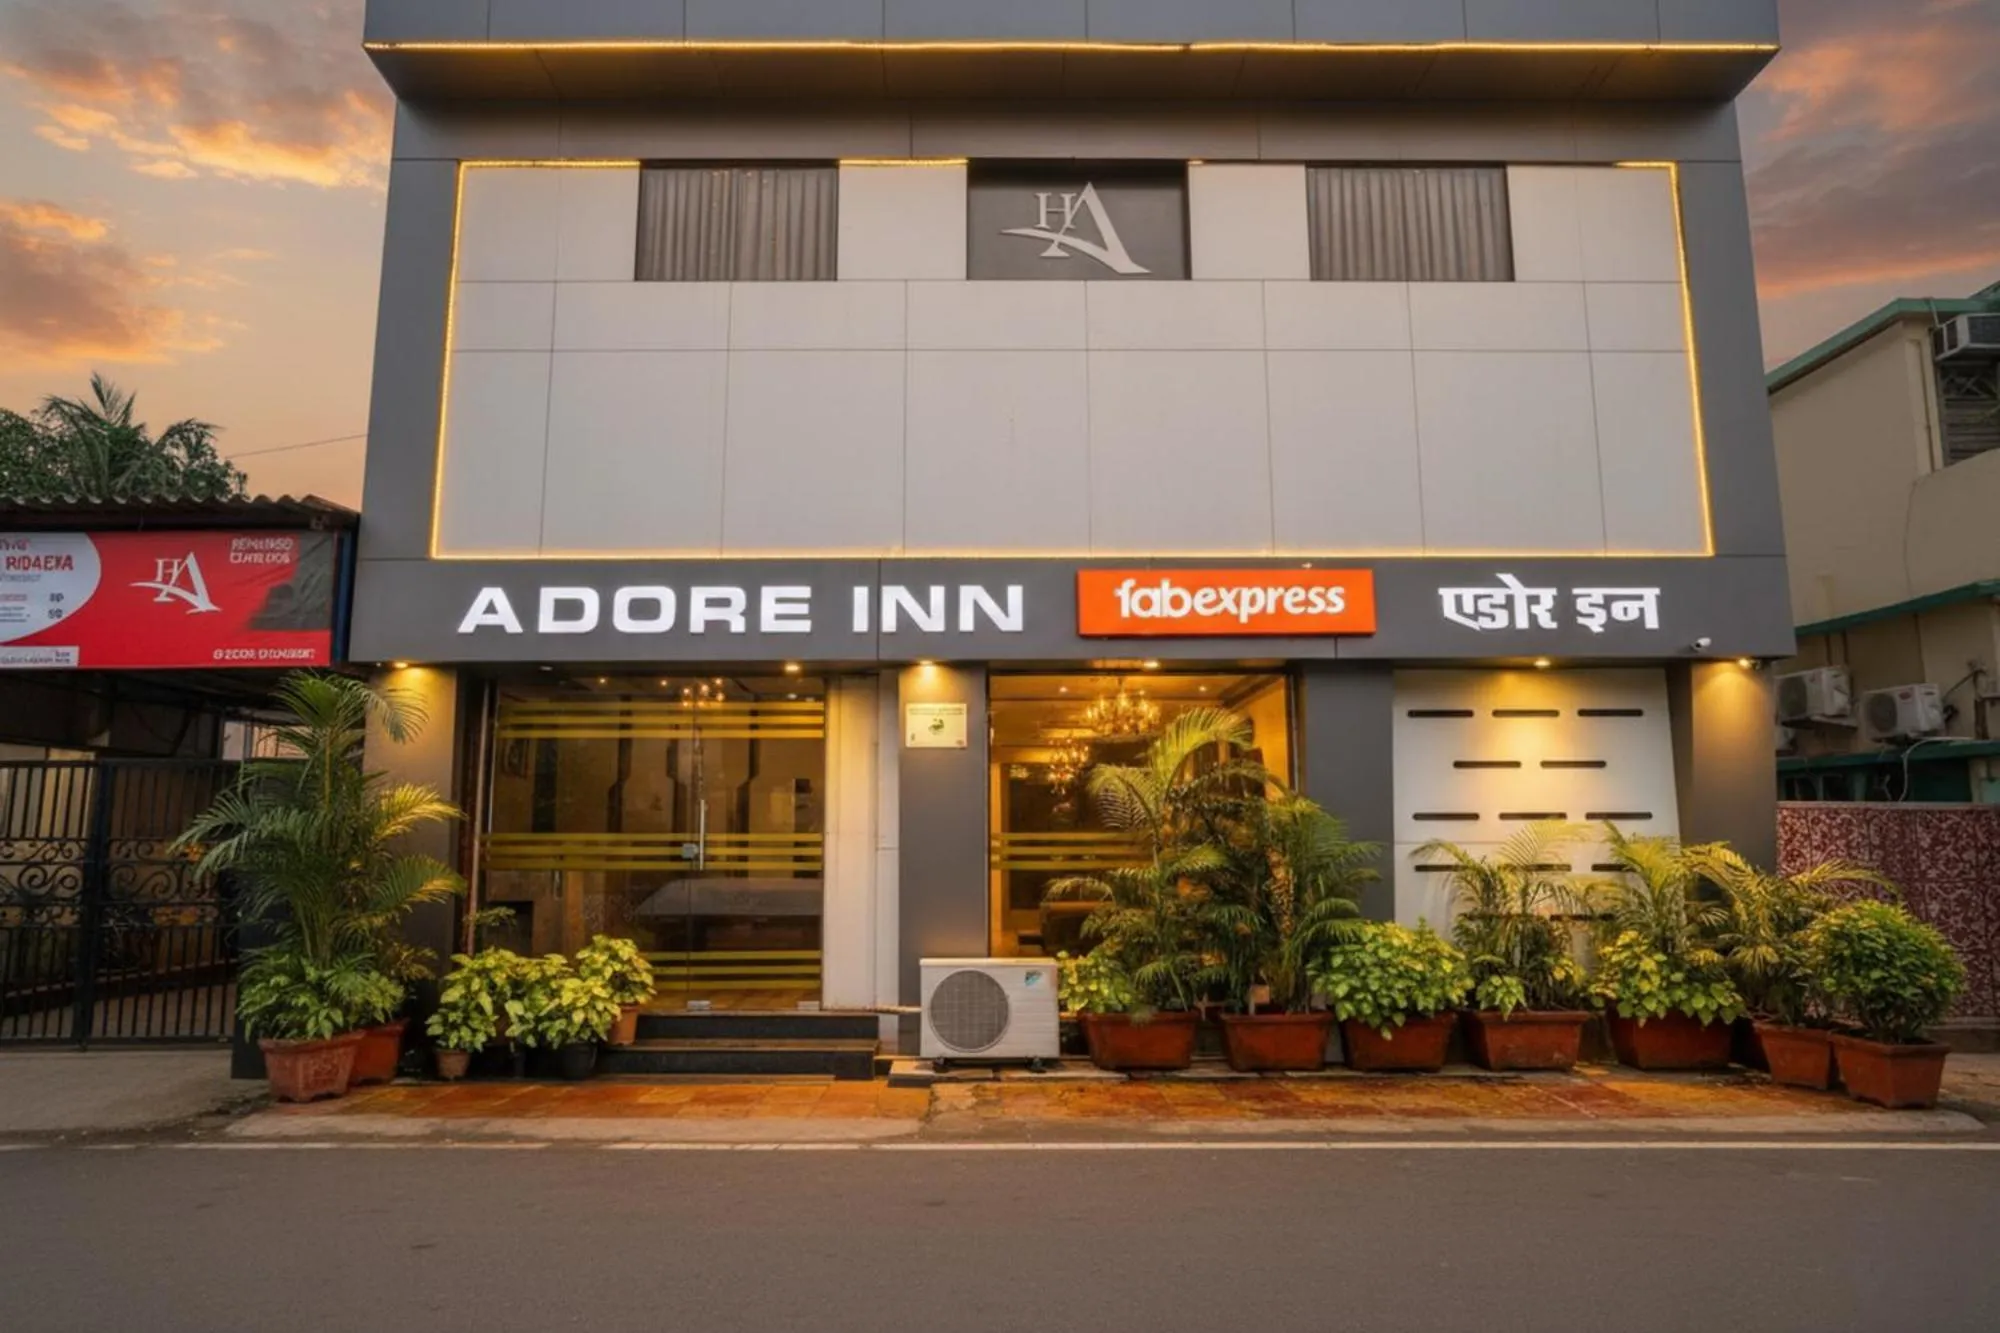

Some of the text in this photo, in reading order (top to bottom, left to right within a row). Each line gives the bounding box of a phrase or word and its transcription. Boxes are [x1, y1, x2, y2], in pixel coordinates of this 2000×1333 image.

[457, 585, 1023, 633] ADORE INN
[1114, 578, 1346, 624] fabexpress
[1438, 573, 1661, 633] एडोर इन
